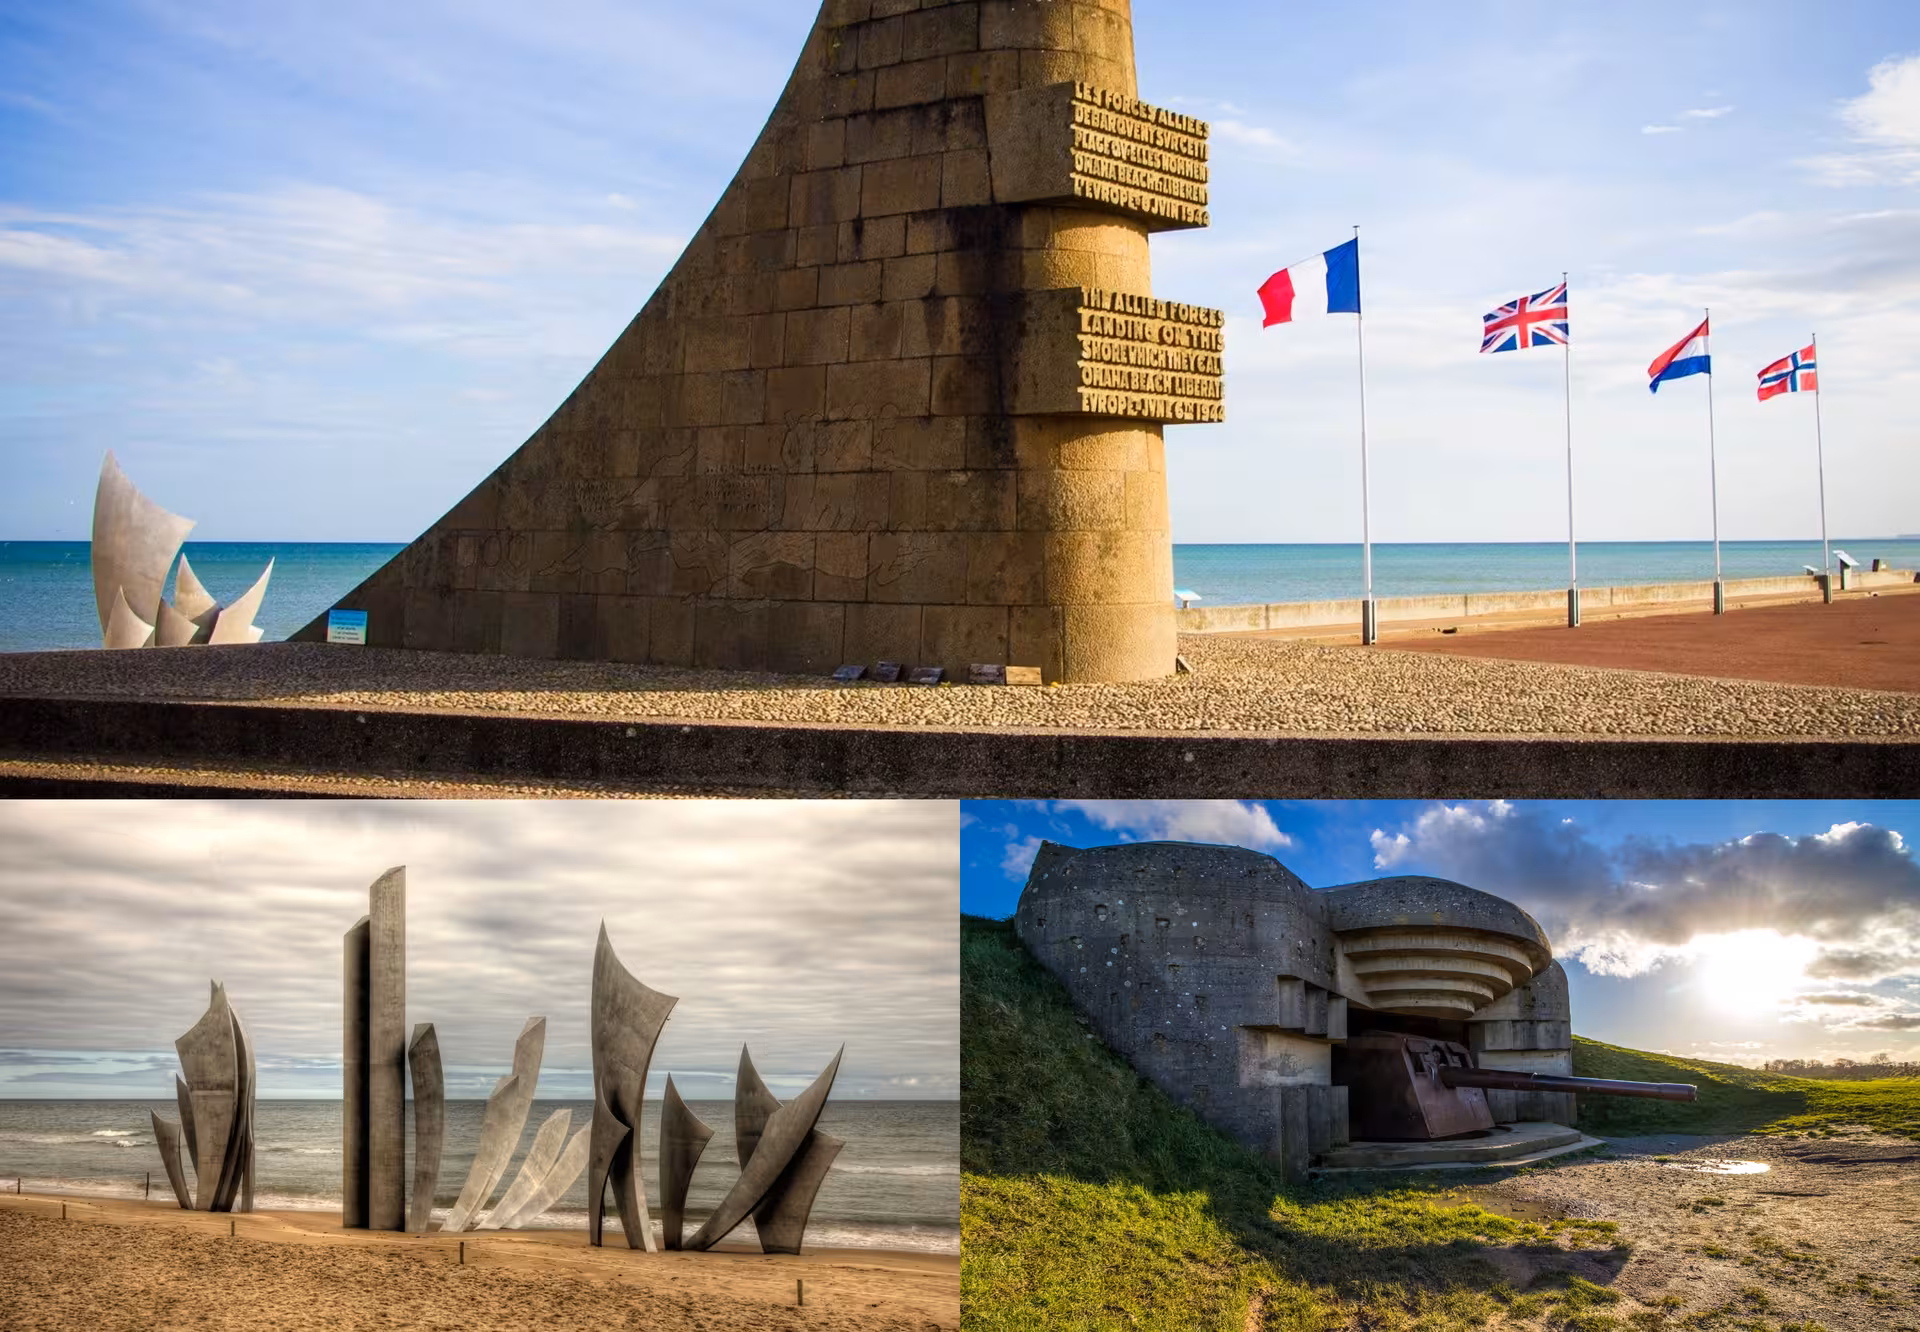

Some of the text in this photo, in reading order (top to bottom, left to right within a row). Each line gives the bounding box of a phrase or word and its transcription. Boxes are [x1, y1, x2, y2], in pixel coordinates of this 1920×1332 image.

[1075, 82, 1101, 107] LES
[1105, 90, 1157, 122] FORCES
[1075, 128, 1111, 155] PLAGE
[1161, 153, 1208, 182] NOMMEN
[1075, 151, 1117, 181] OMAHA
[1117, 164, 1154, 190] BEACH
[1163, 178, 1208, 204] LIBEREN
[1180, 203, 1210, 227] 1944
[1114, 292, 1166, 319] ALLIED
[1169, 302, 1225, 327] FORCES
[1081, 311, 1225, 352] LANDING ON THIS
[1081, 339, 1128, 363] SHORE
[1128, 345, 1167, 369] WHICH
[1167, 350, 1195, 371] THEY
[1081, 366, 1129, 389] OMAHA
[1131, 369, 1172, 393] BEACH
[1196, 402, 1225, 422] 1944
